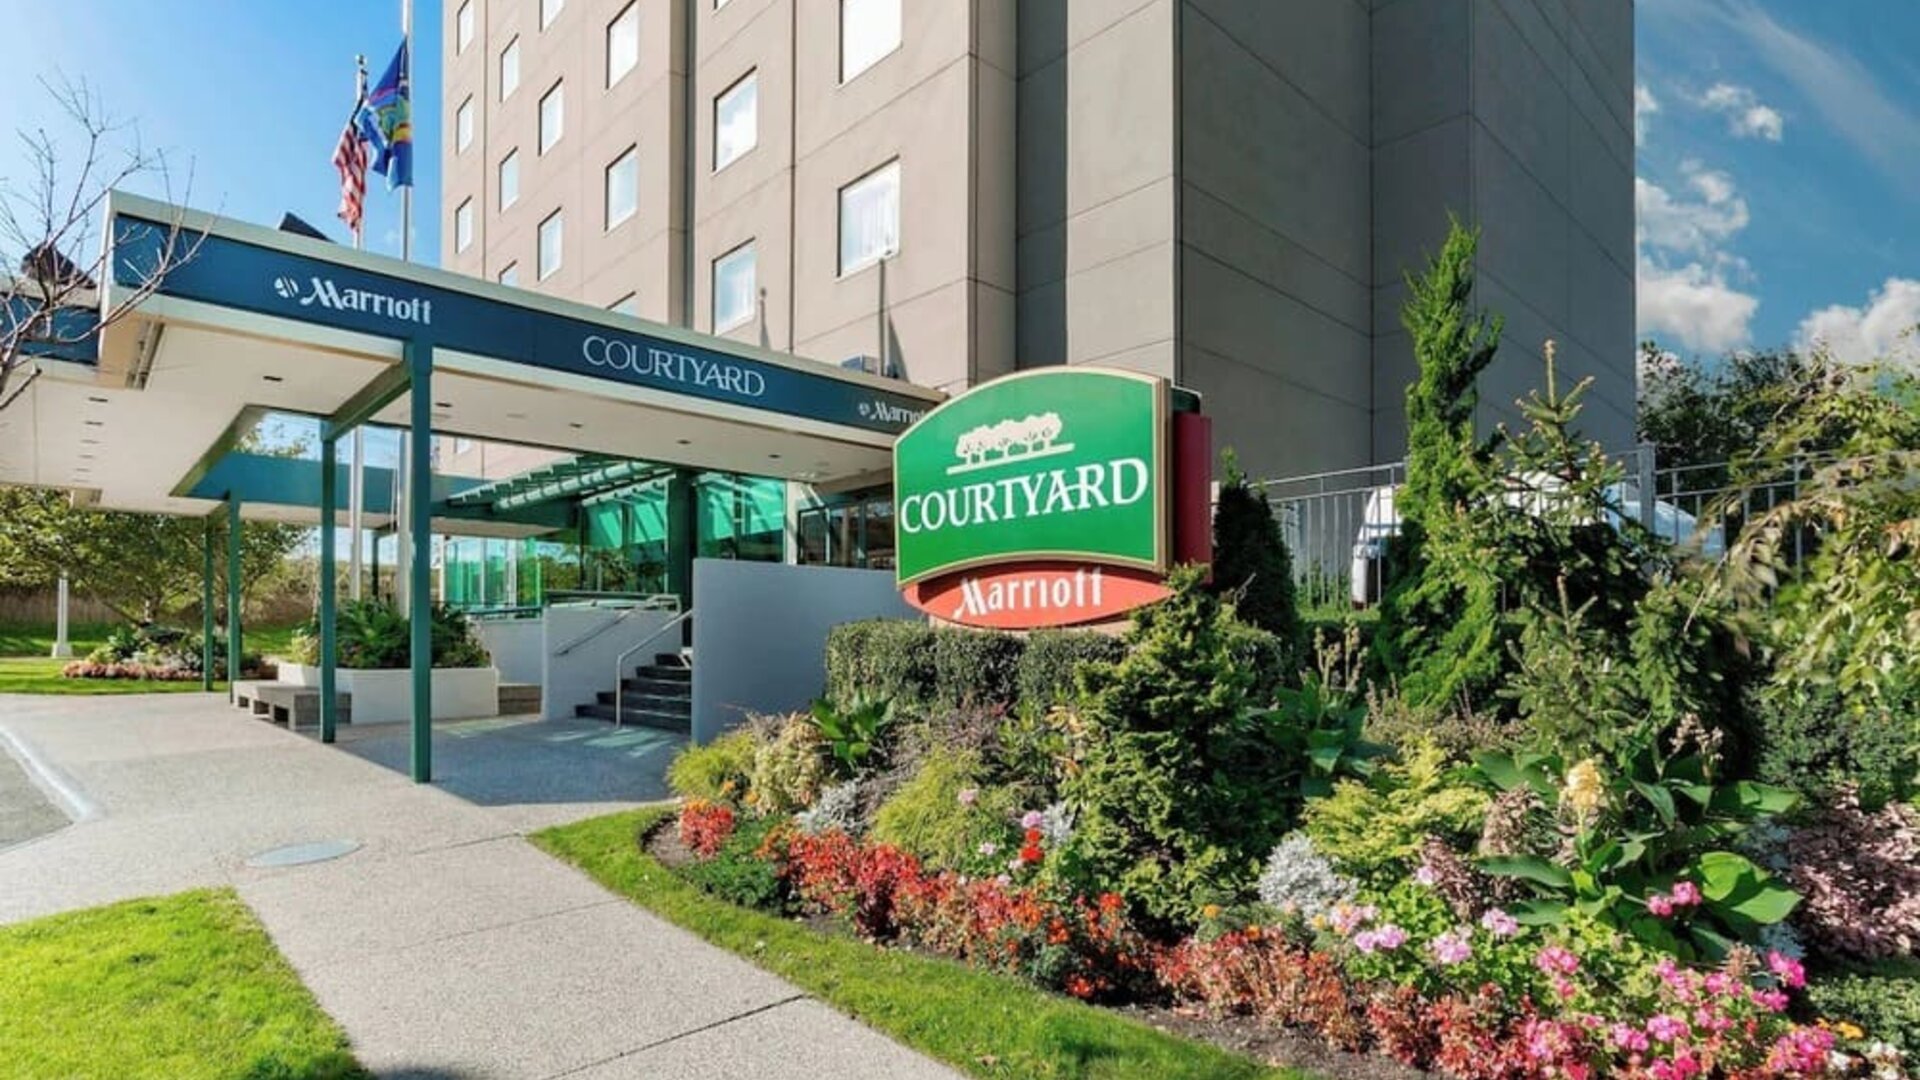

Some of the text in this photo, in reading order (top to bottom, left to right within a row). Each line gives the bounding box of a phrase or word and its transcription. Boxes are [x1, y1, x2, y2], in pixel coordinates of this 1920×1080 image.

[300, 277, 432, 325] Marriott
[582, 335, 766, 398] COURTYARD
[900, 457, 1149, 534] COURTYARD
[952, 567, 1104, 620] Marriott
